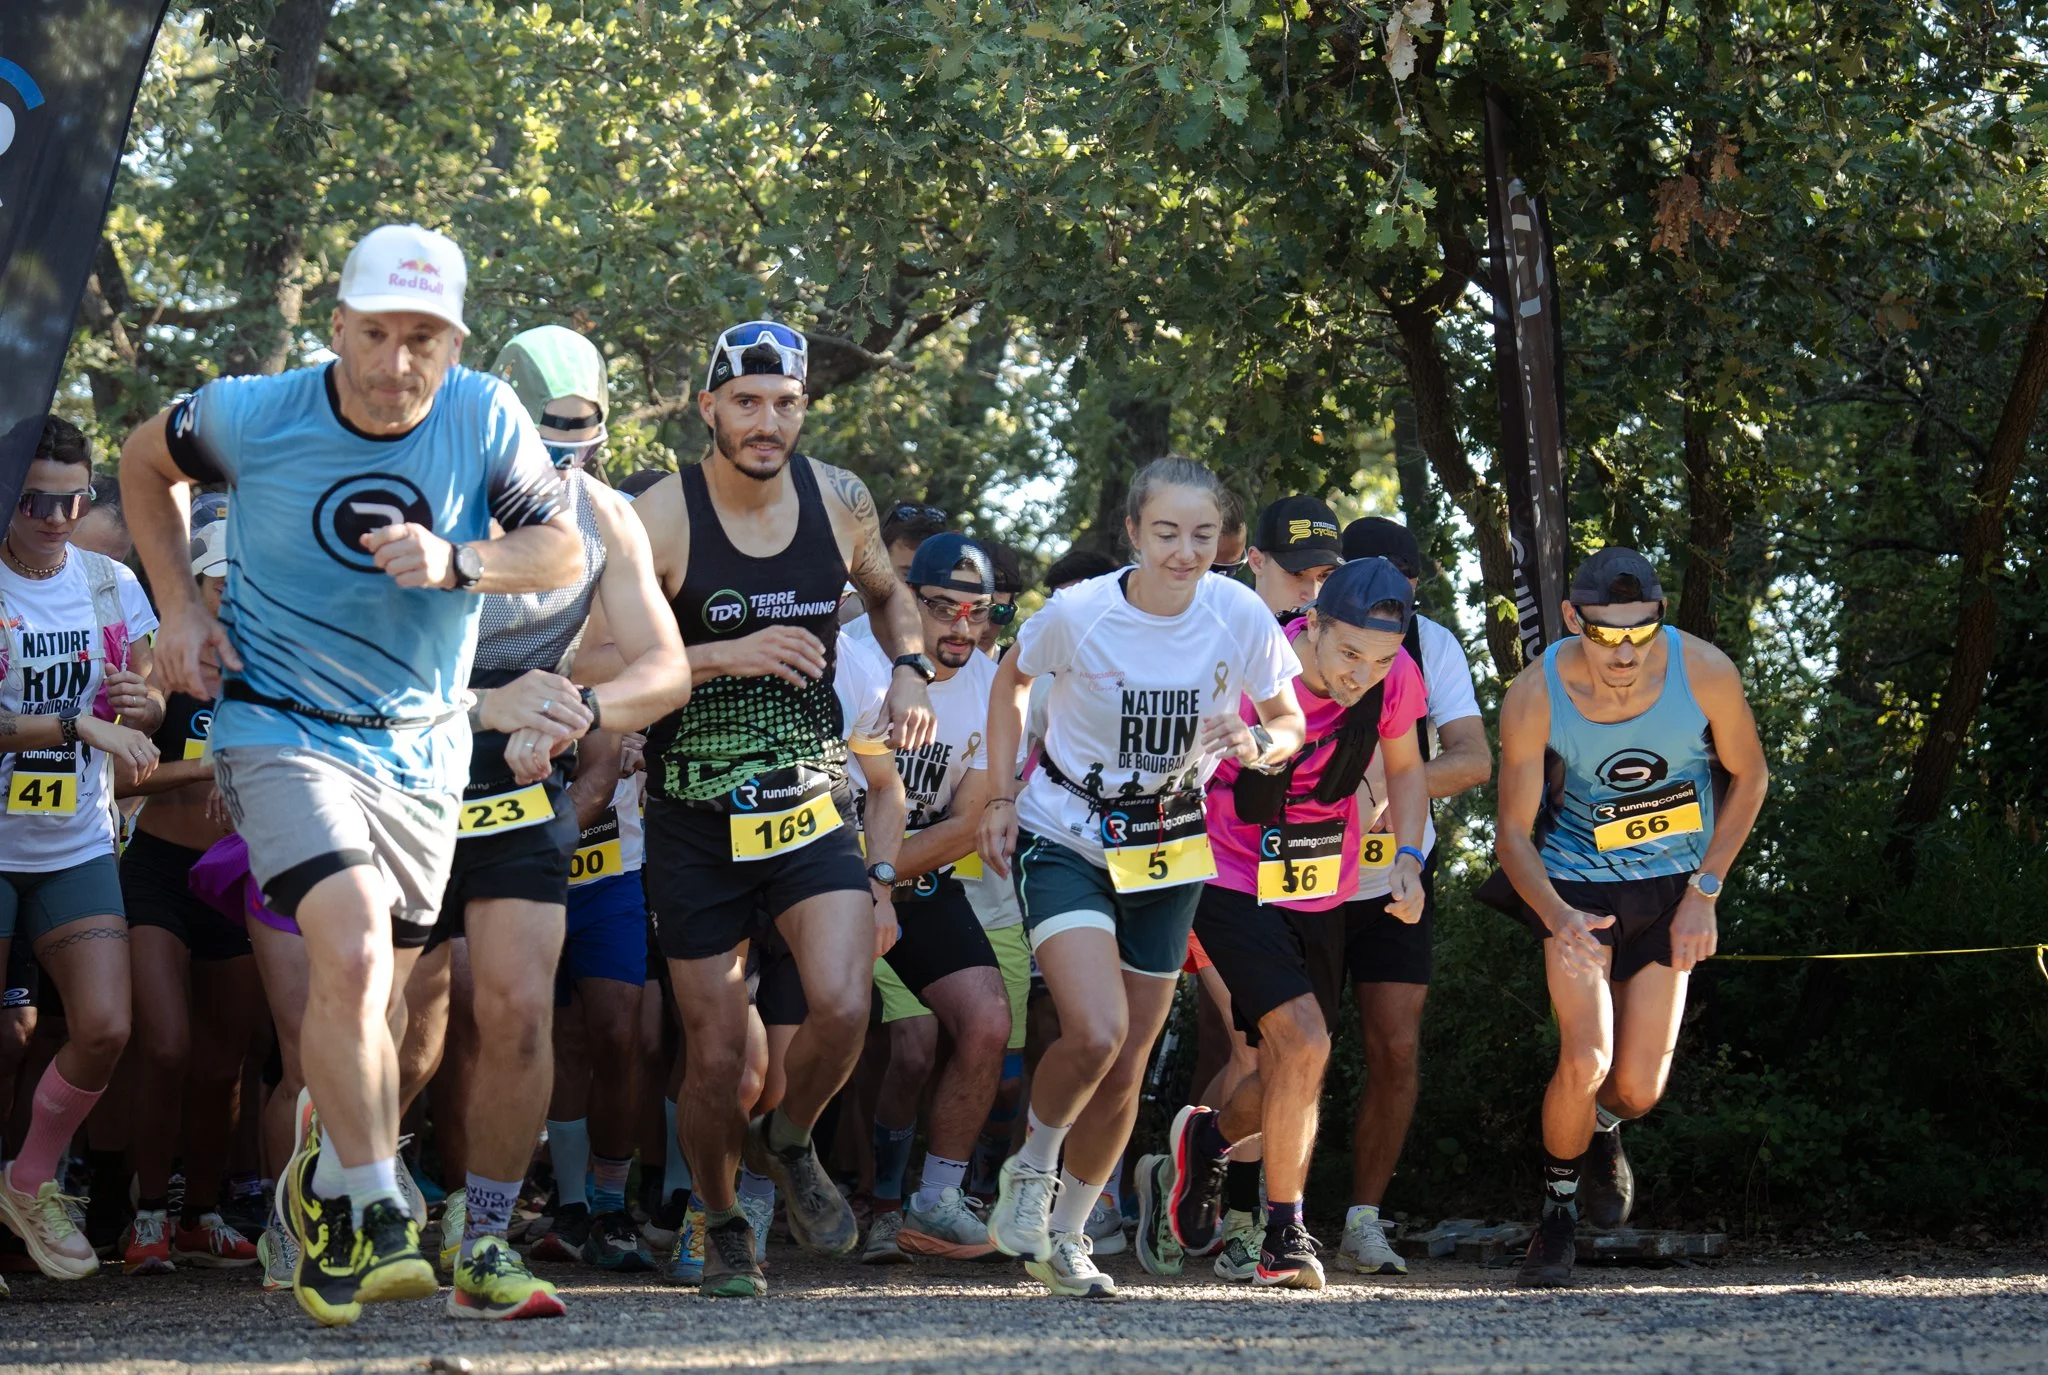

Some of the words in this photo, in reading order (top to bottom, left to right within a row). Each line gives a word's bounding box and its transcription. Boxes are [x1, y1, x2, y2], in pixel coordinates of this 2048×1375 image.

[388, 273, 417, 288] Red
[419, 278, 444, 295] Bull
[749, 591, 796, 609] TERRE
[756, 607, 771, 618] DE
[770, 600, 837, 619] RUNNING
[708, 603, 742, 622] TDR
[22, 630, 91, 658] NATURE
[23, 660, 92, 702] RUN
[21, 701, 35, 715] DE
[1121, 689, 1200, 716] NATURE
[1119, 715, 1199, 756] RUN
[1118, 753, 1133, 769] DE
[18, 779, 63, 808] 41
[1619, 788, 1694, 812] runningconseil
[458, 799, 526, 830] 23
[1131, 809, 1202, 833] runningconseil
[754, 808, 817, 850] 169
[1625, 815, 1670, 840] 66
[1287, 832, 1343, 849] unningconseil
[1364, 839, 1384, 863] 8
[1148, 850, 1169, 880] 5
